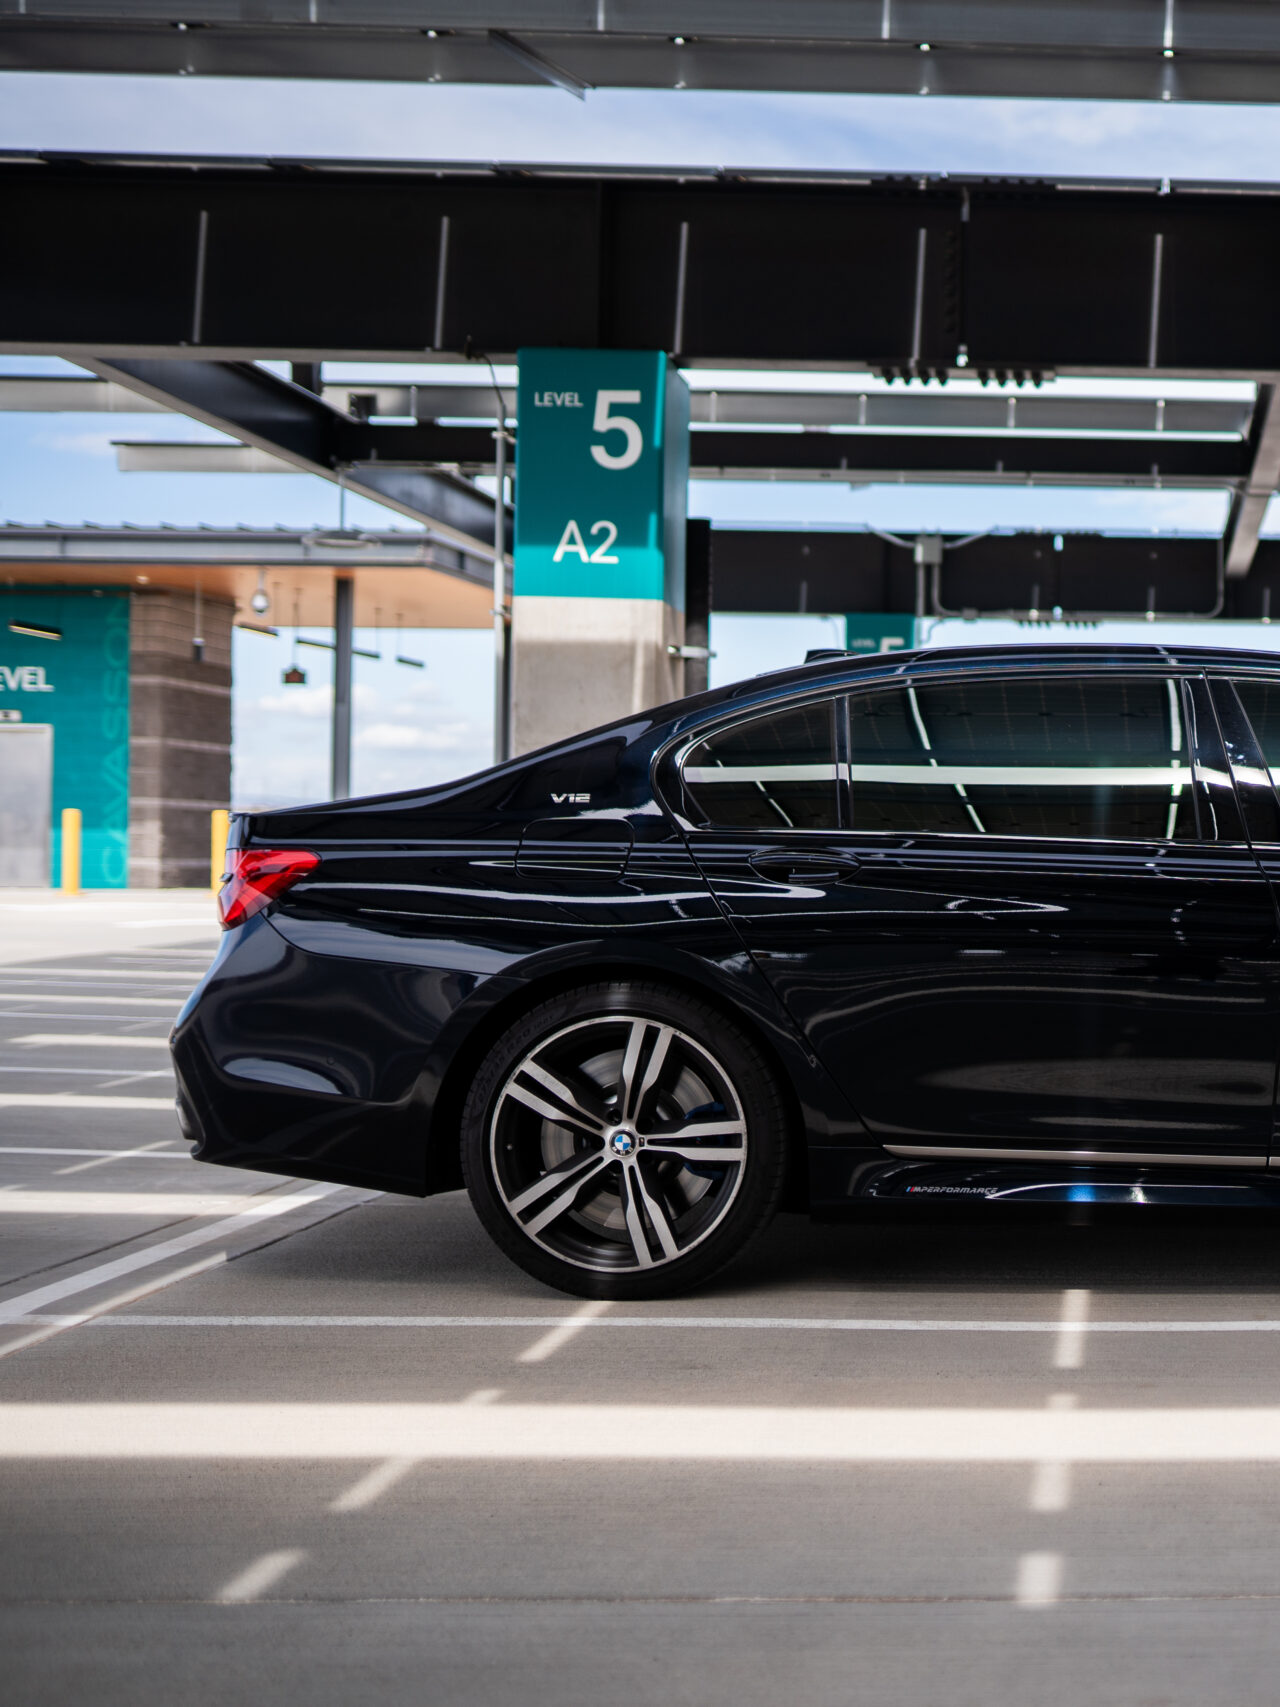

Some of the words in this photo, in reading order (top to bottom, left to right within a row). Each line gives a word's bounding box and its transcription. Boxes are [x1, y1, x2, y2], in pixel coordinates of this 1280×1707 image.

[534, 392, 583, 407] LEVEL
[590, 389, 643, 470] 5
[553, 519, 620, 564] A2
[551, 793, 591, 803] V12
